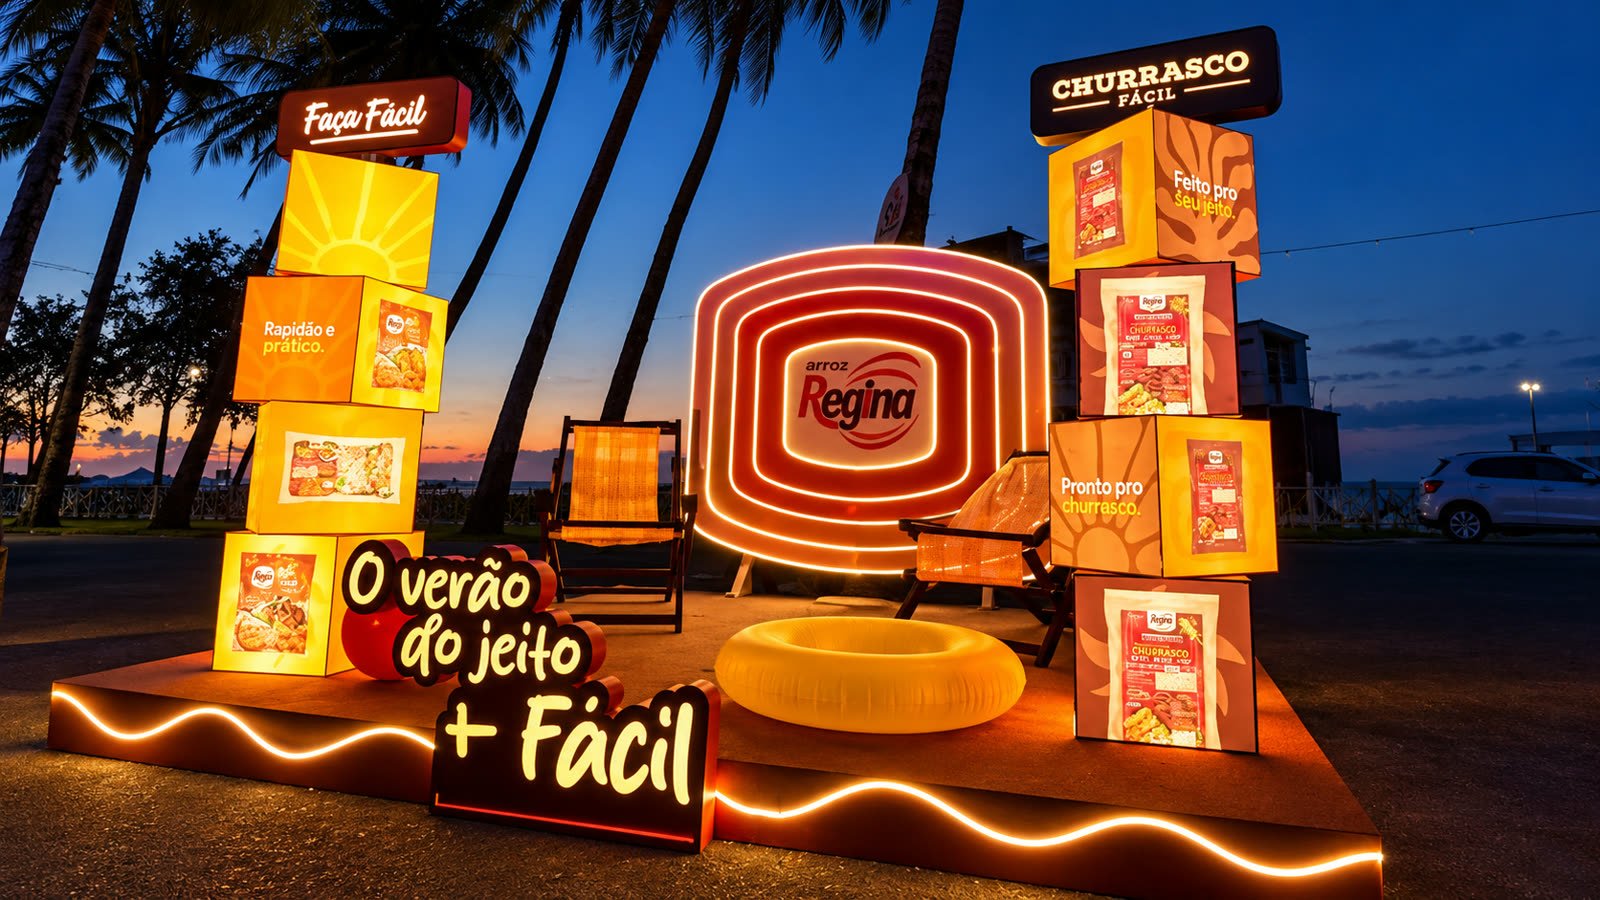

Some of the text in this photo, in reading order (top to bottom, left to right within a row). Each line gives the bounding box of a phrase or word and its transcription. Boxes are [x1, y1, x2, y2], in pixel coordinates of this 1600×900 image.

[1052, 50, 1249, 100] CHURRASCO
[1117, 87, 1177, 107] FÁCIL
[304, 94, 426, 135] Faça Fácil
[1174, 170, 1238, 202] Feito pro
[1175, 192, 1236, 219] seu jeito.
[263, 321, 335, 338] Rapidão e
[263, 338, 325, 355] prático.
[805, 361, 849, 372] arroz
[798, 375, 916, 431] Regina
[1061, 477, 1143, 500] Pronto pro
[1062, 496, 1141, 516] churrasco.
[348, 550, 531, 613] O verão
[400, 613, 582, 684] do jeito
[445, 694, 694, 806] + Fácil
